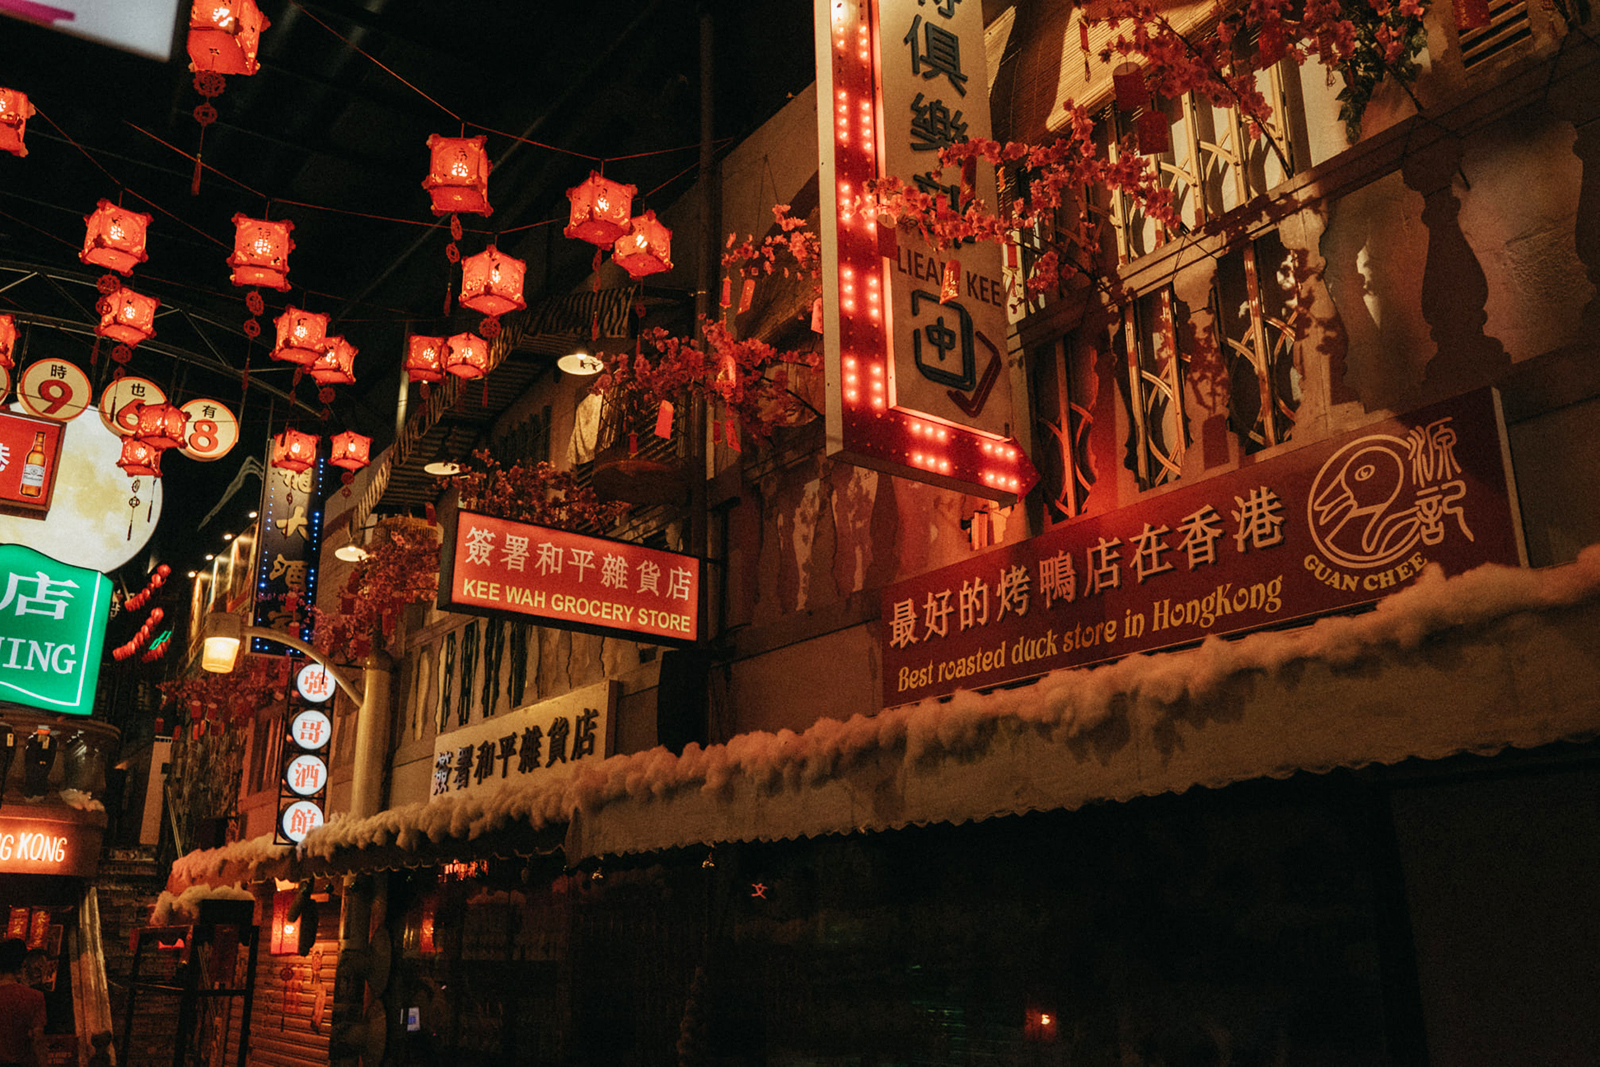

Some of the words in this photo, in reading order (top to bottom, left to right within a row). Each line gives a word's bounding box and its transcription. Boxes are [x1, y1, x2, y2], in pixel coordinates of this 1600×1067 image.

[967, 271, 1001, 307] KEE
[50, 364, 67, 379] 時
[130, 383, 146, 397] 也
[38, 380, 73, 414] 9
[202, 404, 218, 419] 有
[188, 419, 219, 453] 8
[464, 526, 692, 601] 簽署和平雜貨店
[888, 486, 1285, 649] 最好的烤鴨店在香港
[1303, 554, 1360, 592] GUAN
[1363, 552, 1428, 591] CHEE
[463, 578, 500, 601] KEE
[505, 585, 546, 608] WAH
[551, 593, 634, 623] GROCERY
[638, 607, 691, 633] STORE
[0, 636, 77, 674] ING
[897, 663, 934, 692] Best
[938, 640, 1006, 680] roasted
[1011, 628, 1058, 666] duck
[1063, 617, 1117, 653] store
[1123, 609, 1145, 638] in
[289, 670, 330, 837] 強哥酒館
[17, 832, 68, 862] KONG
